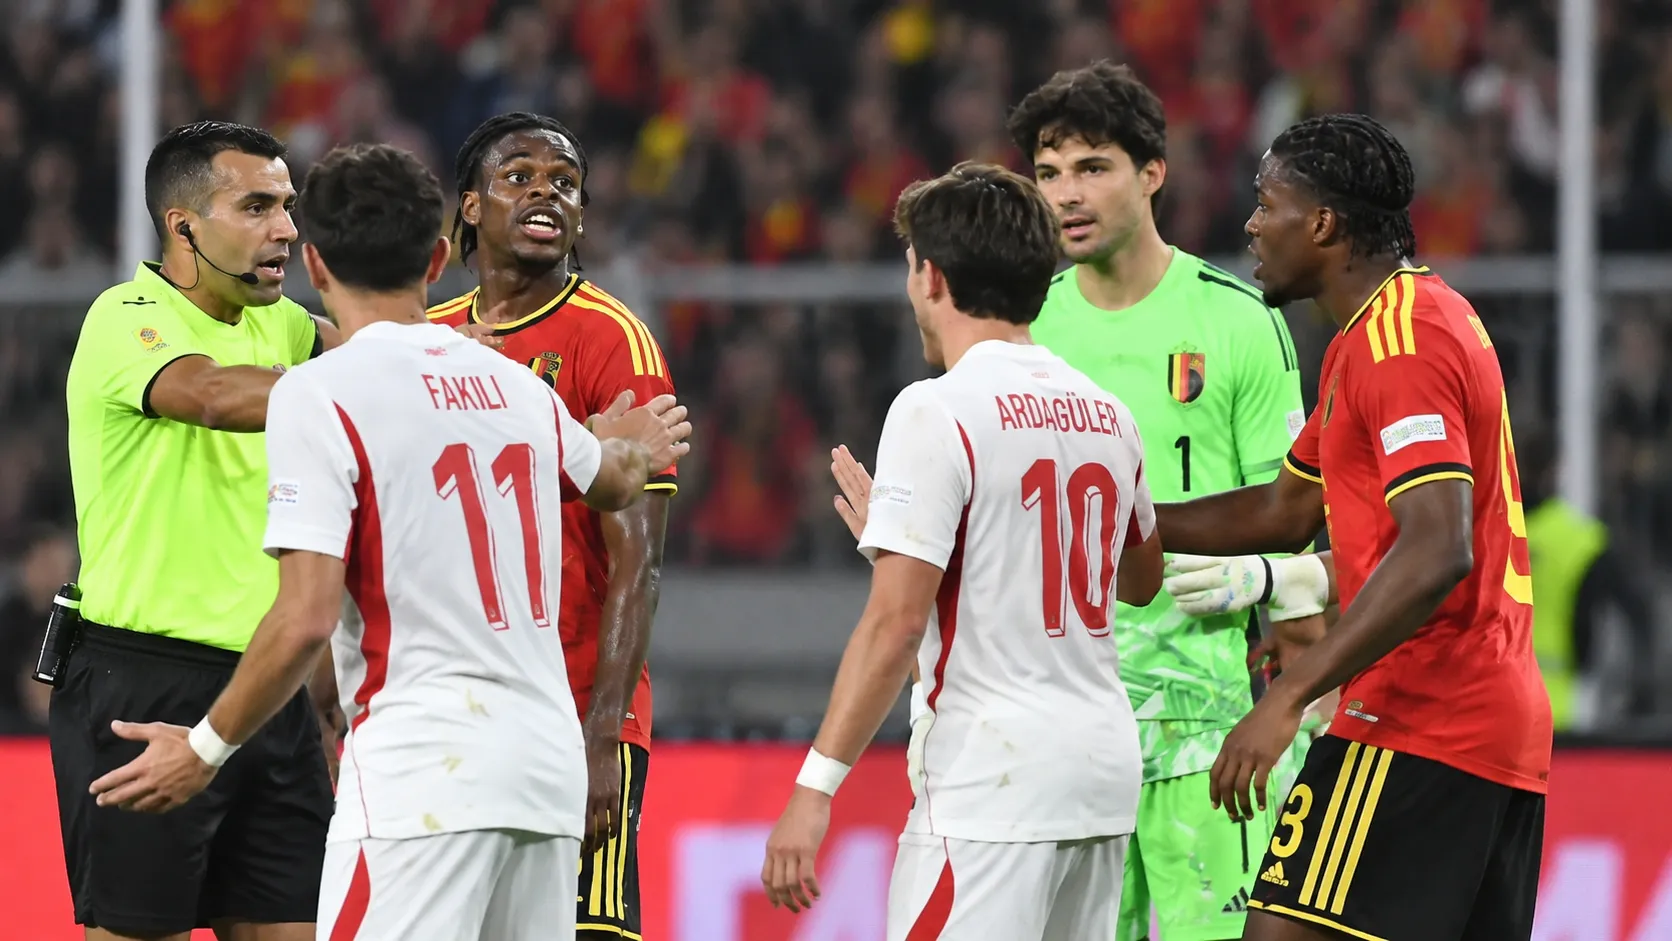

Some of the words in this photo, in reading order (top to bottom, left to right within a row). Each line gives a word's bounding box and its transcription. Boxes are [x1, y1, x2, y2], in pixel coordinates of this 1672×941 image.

[421, 373, 508, 411] FAKILI
[994, 391, 1123, 439] ARDAGÜLER
[1174, 435, 1191, 493] 1
[431, 442, 551, 631] 11
[1020, 458, 1121, 638] 10
[1270, 783, 1314, 858] 3
